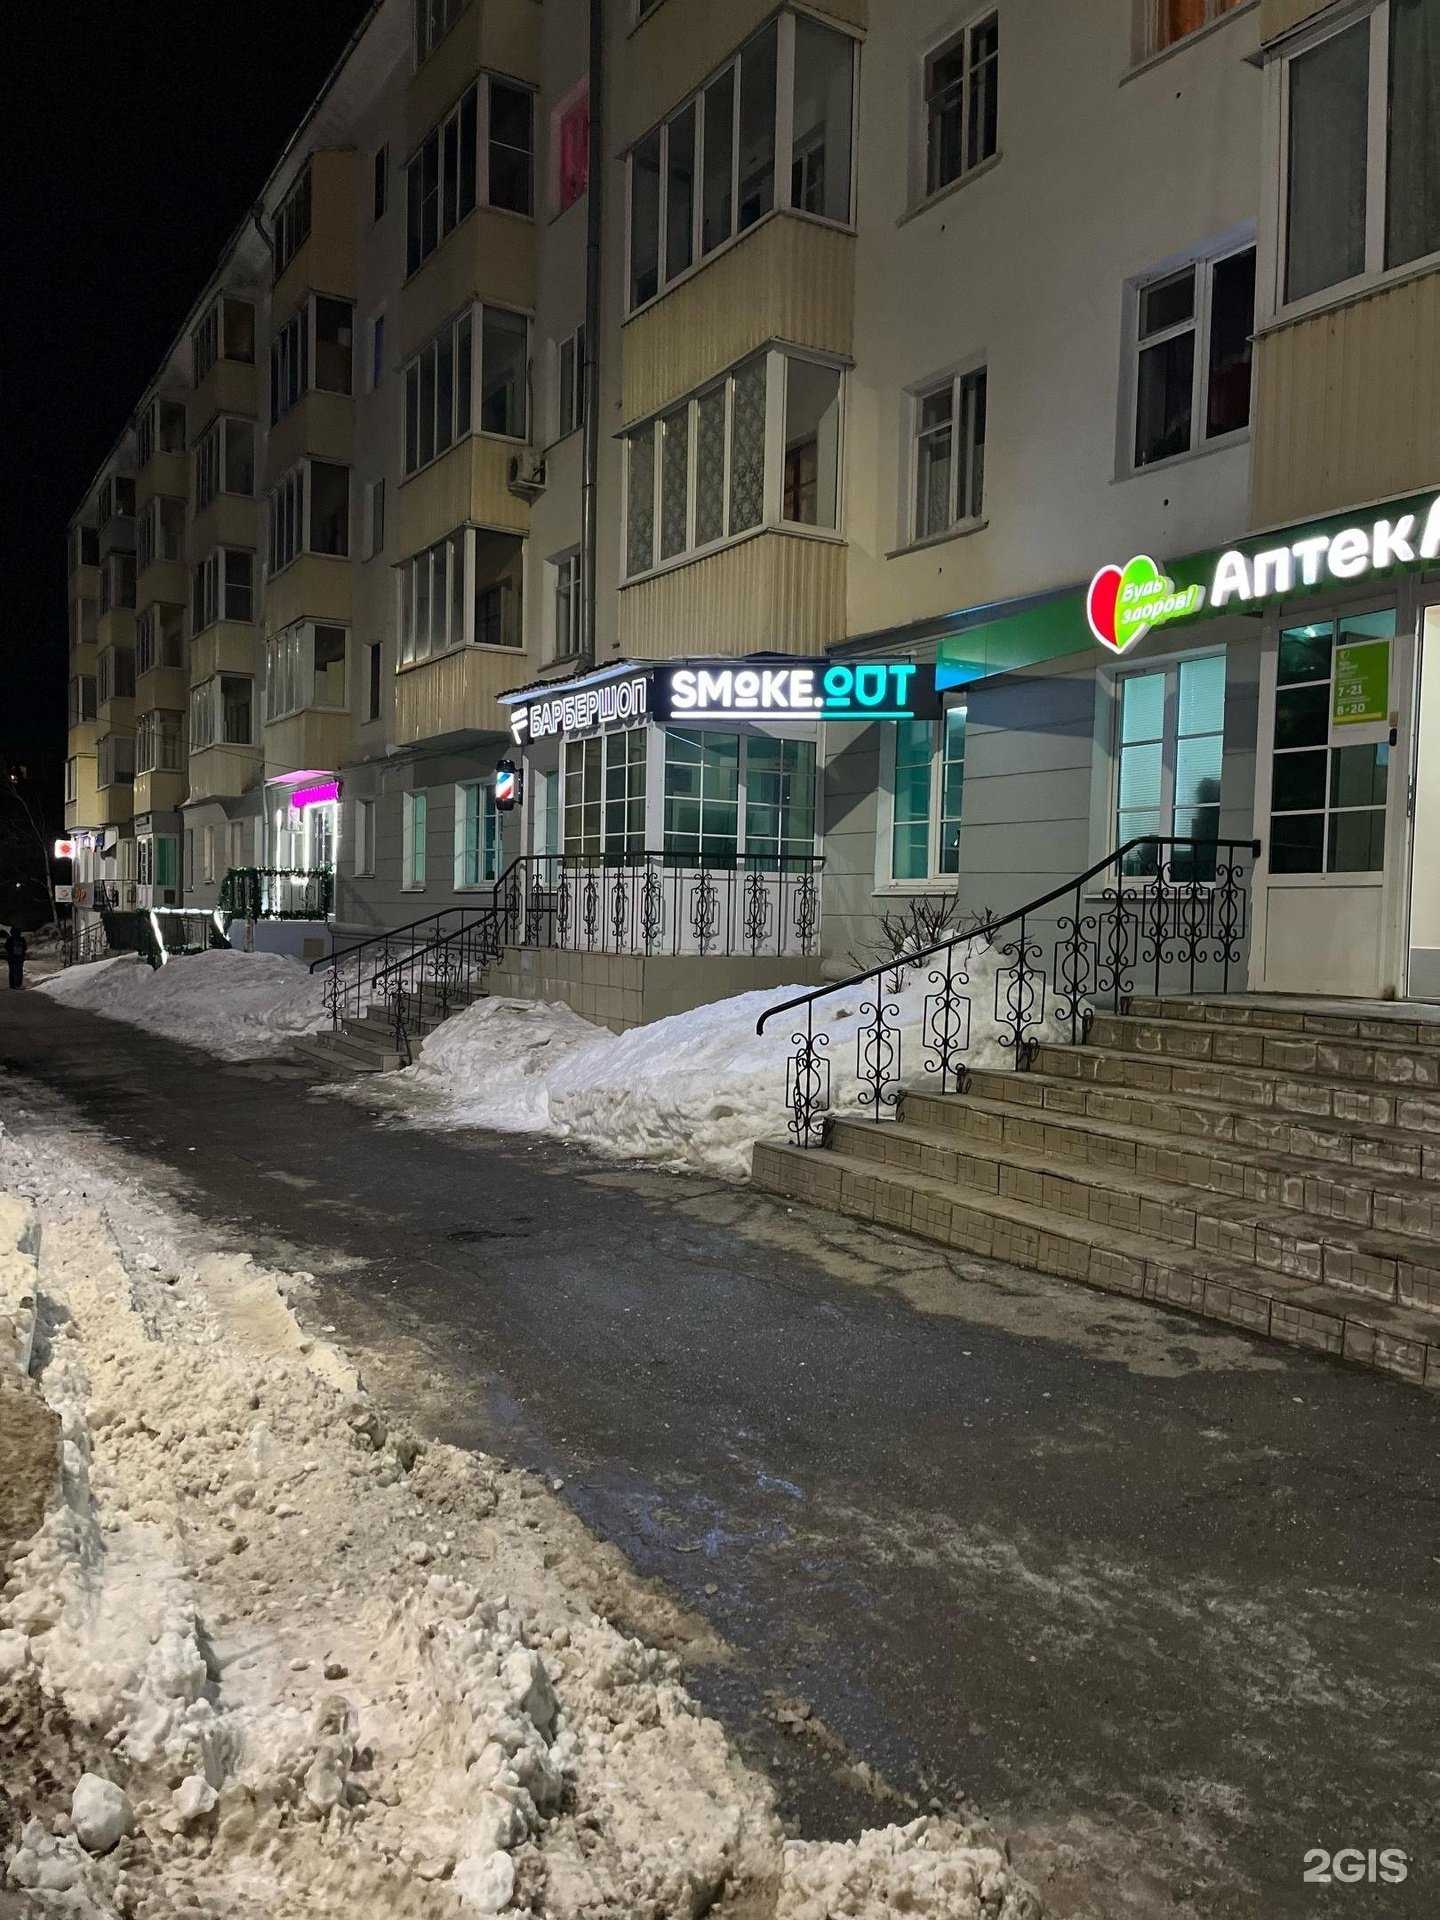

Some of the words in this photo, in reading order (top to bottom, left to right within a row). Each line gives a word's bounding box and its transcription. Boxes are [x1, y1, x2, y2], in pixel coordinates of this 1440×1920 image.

[1121, 581, 1163, 602] Будь
[1122, 590, 1194, 624] здоров!
[670, 664, 916, 708] SMOKE.OUT
[529, 677, 647, 738] БАРБЕРШОП
